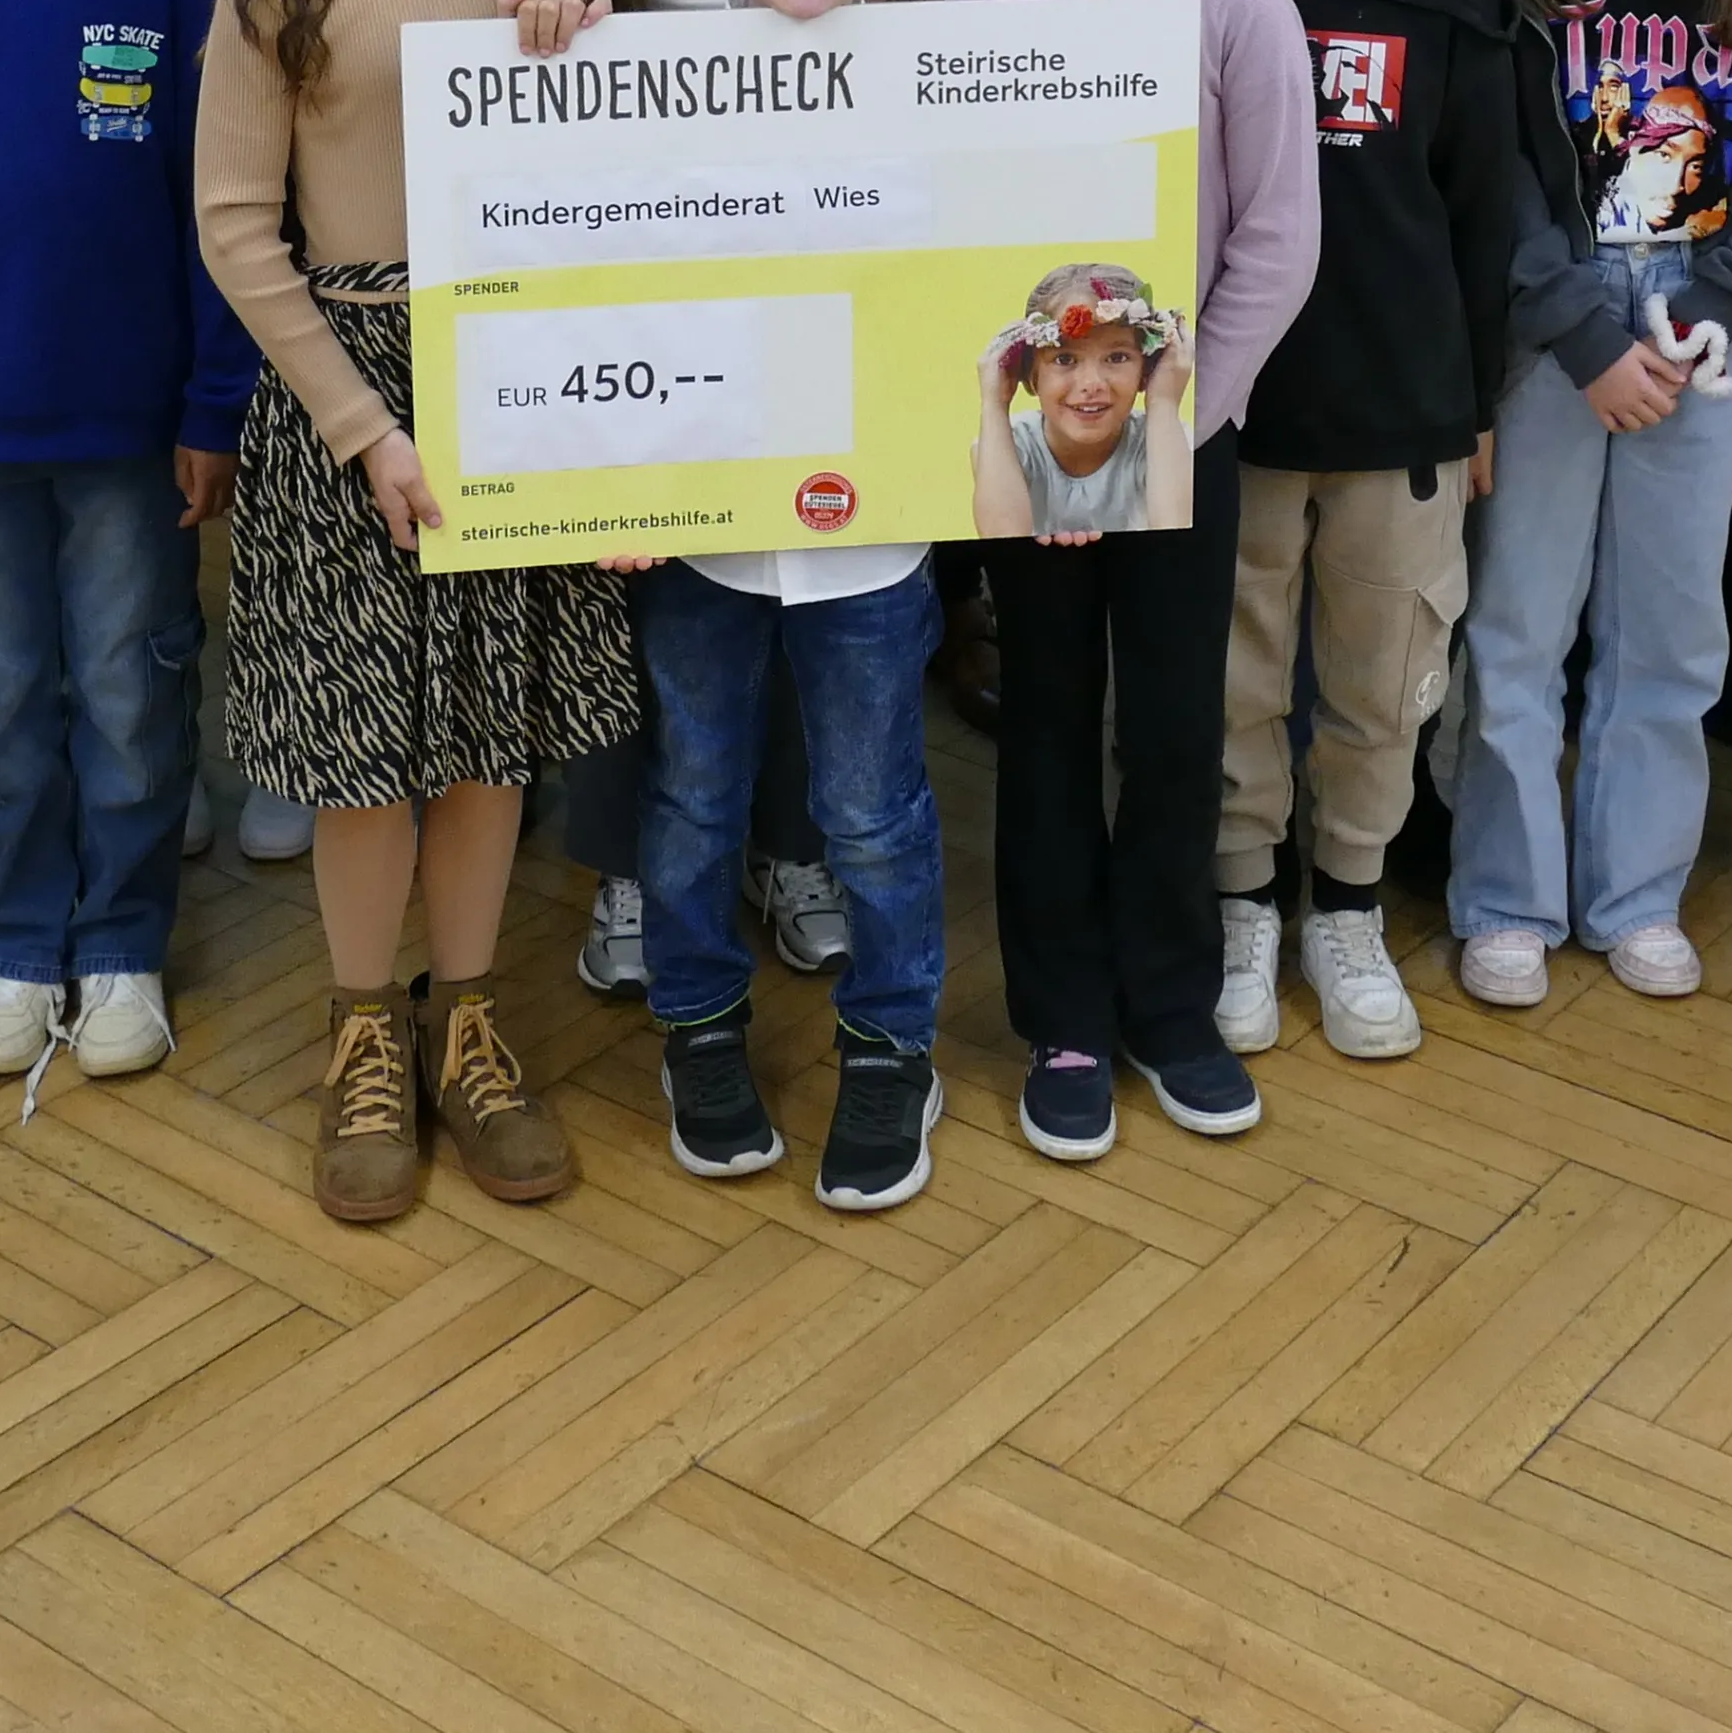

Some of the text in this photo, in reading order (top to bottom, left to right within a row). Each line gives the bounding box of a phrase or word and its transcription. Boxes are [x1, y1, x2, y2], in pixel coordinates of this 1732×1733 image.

[83, 24, 165, 50] NYC SKATE
[916, 49, 1066, 76] Steirische
[447, 51, 855, 129] SPENDENSCHECK
[916, 72, 1159, 106] Kinderkrebshilfe
[481, 183, 881, 230] Kindergemeinderat Wies
[453, 280, 520, 298] SPENDER
[497, 385, 548, 409] EUR
[460, 482, 515, 498] BETRAG
[460, 507, 735, 544] steirische-kinderkrebshilfe.at
